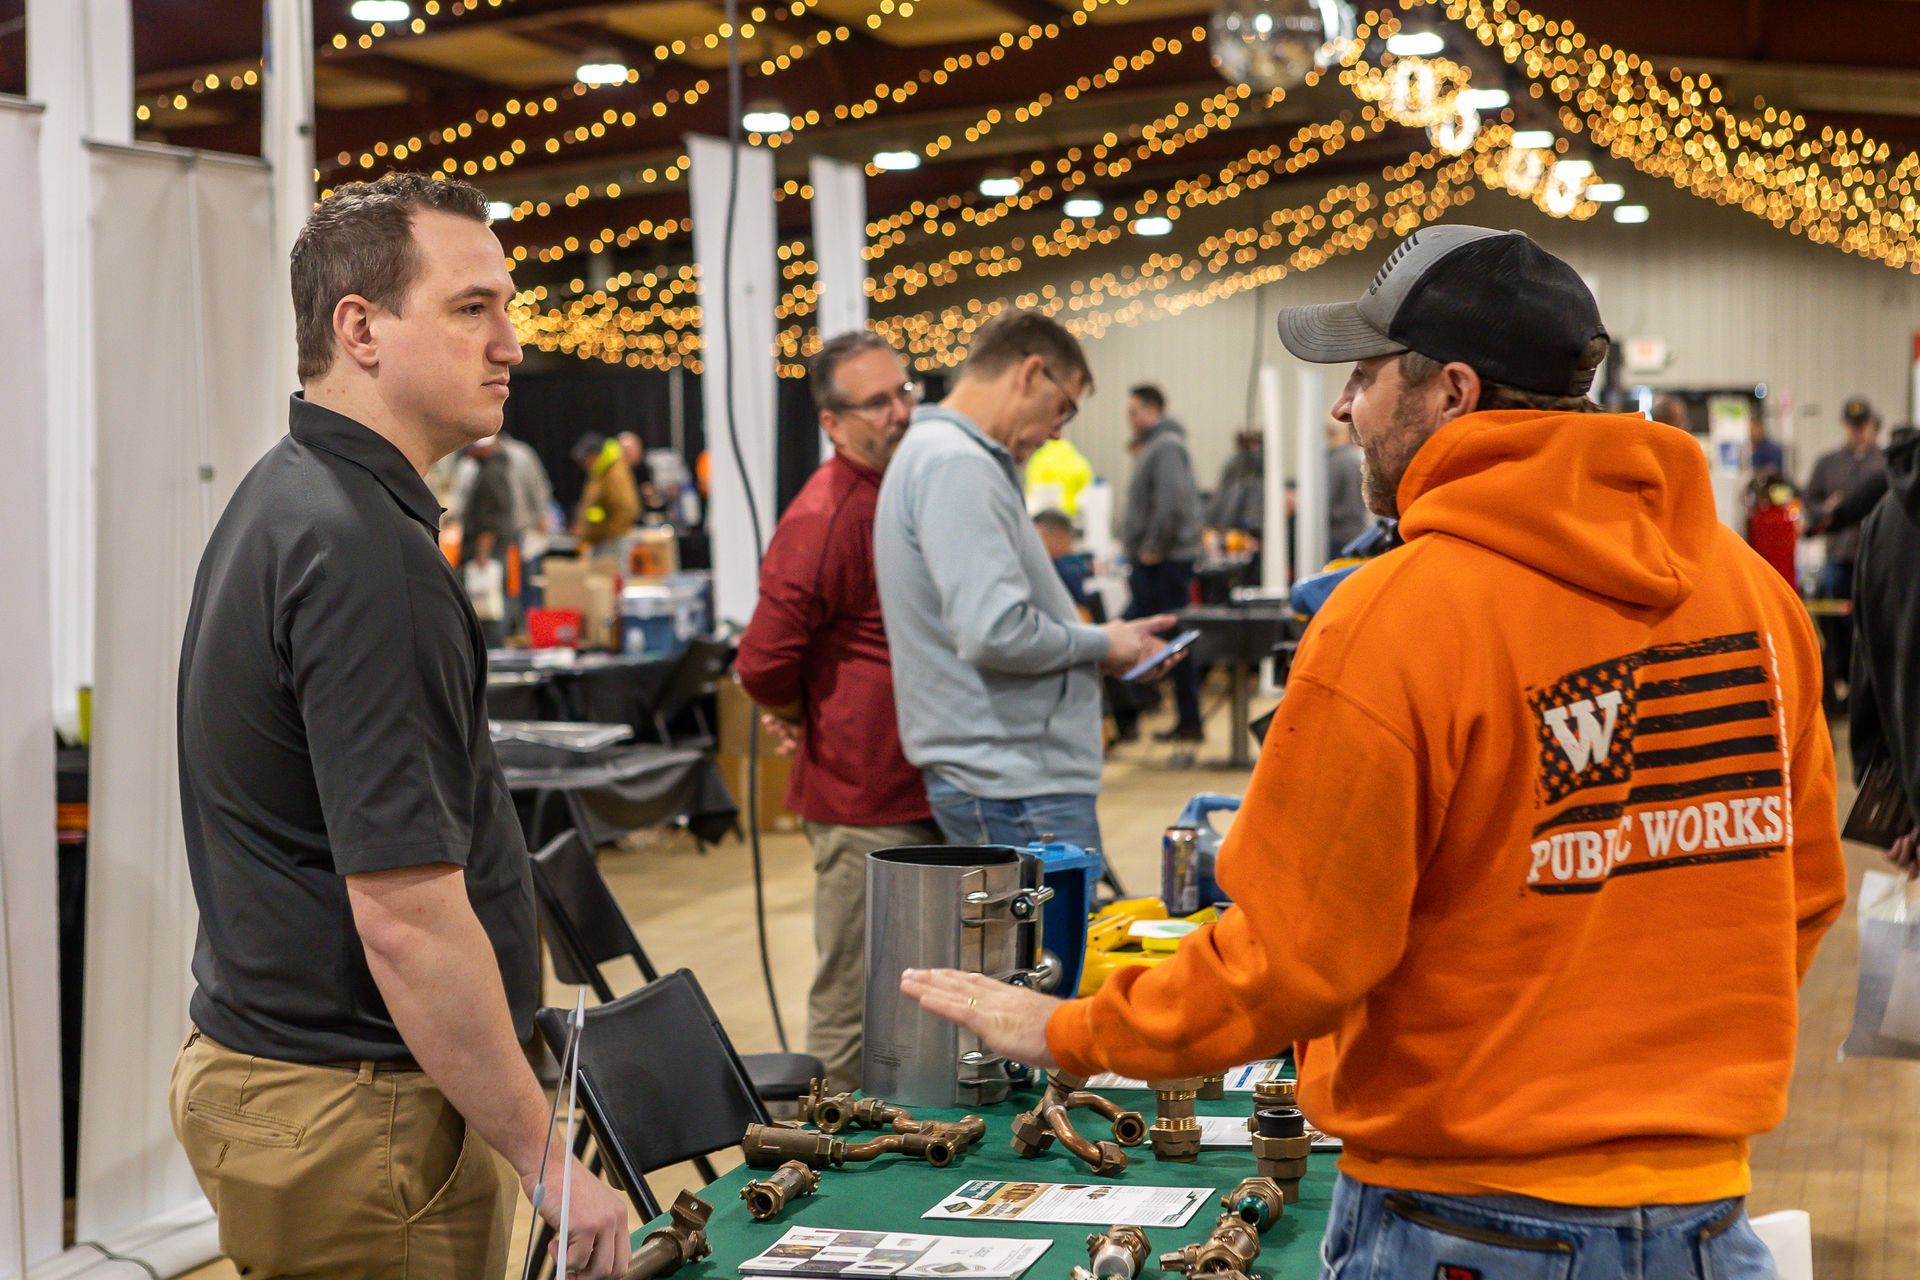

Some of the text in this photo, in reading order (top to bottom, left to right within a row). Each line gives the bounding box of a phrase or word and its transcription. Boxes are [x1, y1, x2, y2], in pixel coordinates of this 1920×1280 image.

[1543, 690, 1623, 774] W
[1526, 814, 1633, 885] PUBLC
[1639, 795, 1784, 858] WORKS
